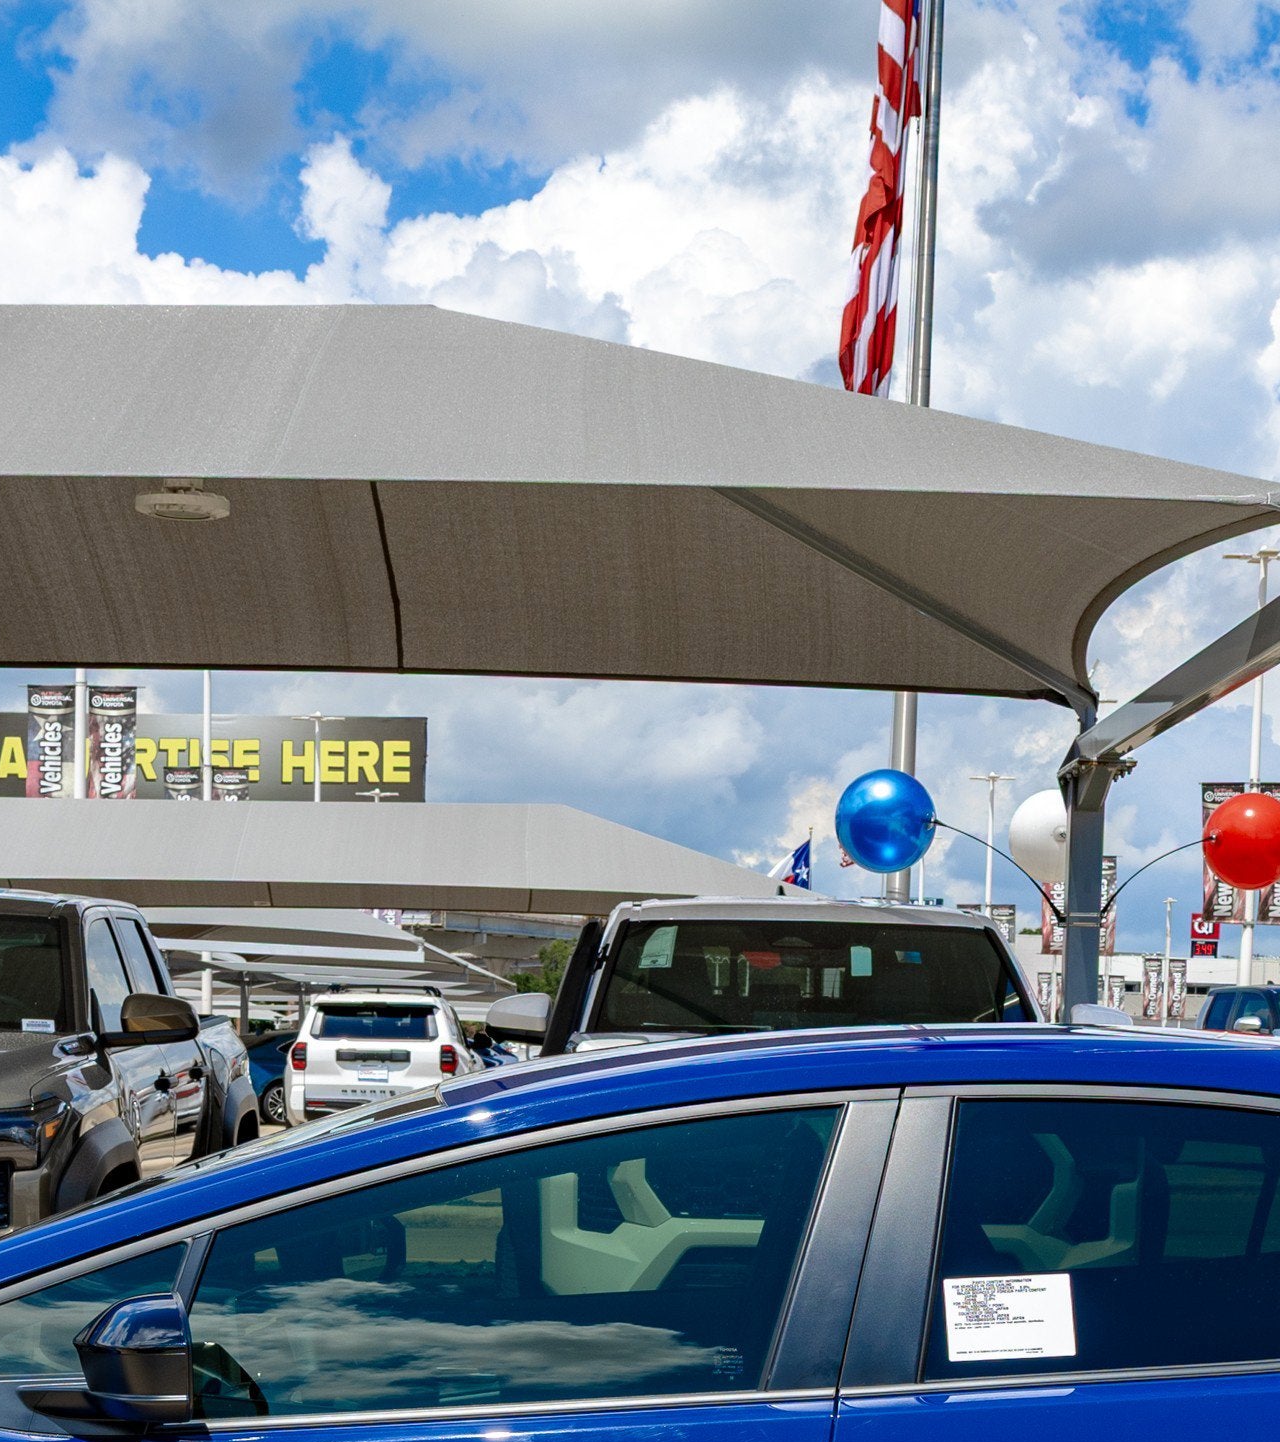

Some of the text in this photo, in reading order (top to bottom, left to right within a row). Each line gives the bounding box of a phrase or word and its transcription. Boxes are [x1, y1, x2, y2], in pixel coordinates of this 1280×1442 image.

[40, 722, 62, 794] Vehicles
[100, 723, 123, 795] Vehicles
[281, 740, 410, 784] HERE
